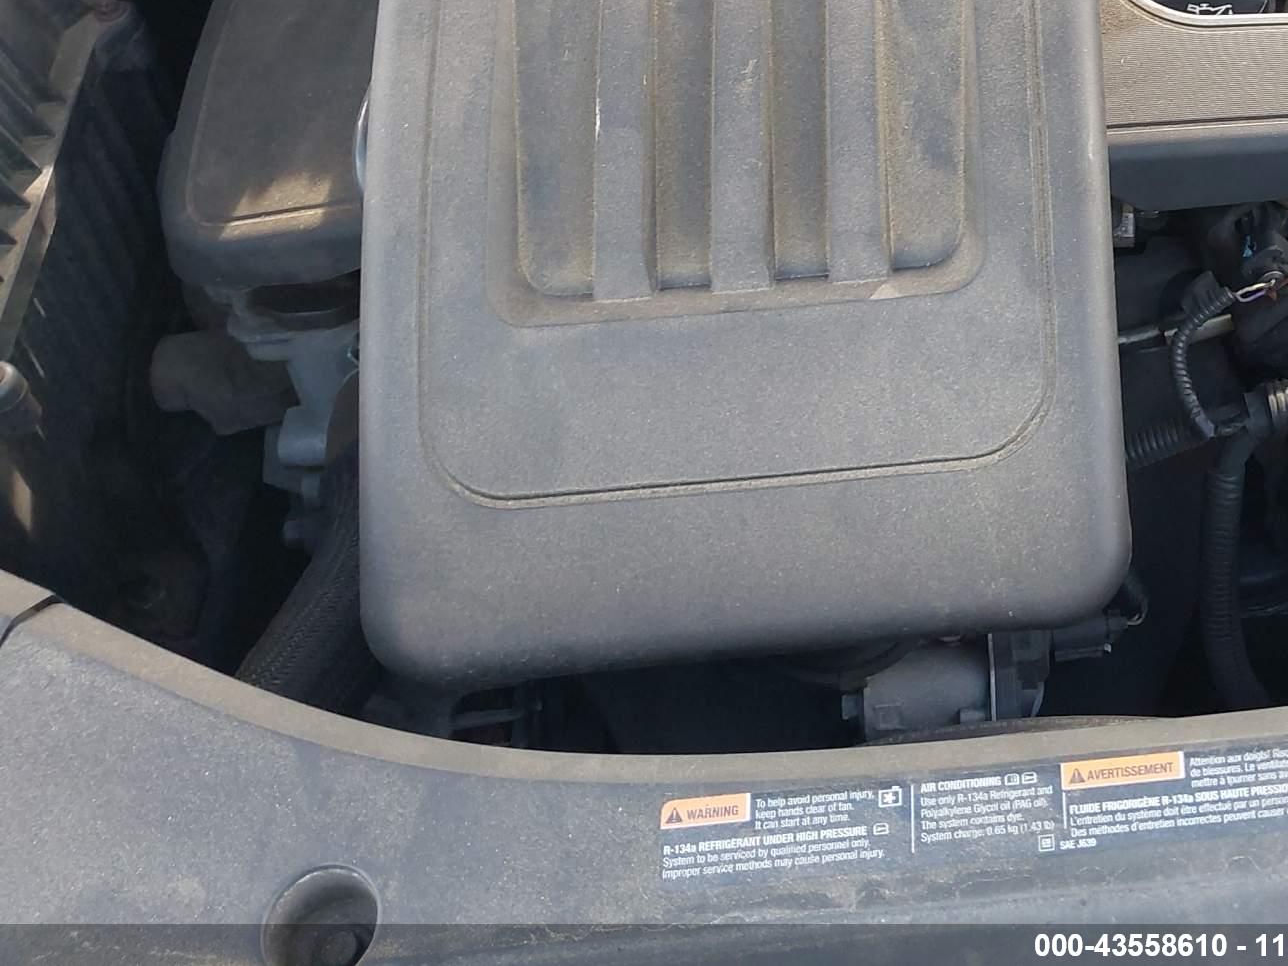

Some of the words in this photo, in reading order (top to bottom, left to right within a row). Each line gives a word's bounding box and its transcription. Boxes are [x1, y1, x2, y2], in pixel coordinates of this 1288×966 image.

[1190, 755, 1226, 767] Attention
[1227, 754, 1242, 763] aux
[1191, 769, 1201, 777] de
[1203, 764, 1243, 776] blessures.
[1245, 763, 1255, 771] Le
[1087, 762, 1174, 781] AVERTISSEMENT
[1192, 777, 1217, 788] mettre
[1219, 776, 1226, 784] à
[1227, 774, 1256, 786] tourner
[1258, 772, 1277, 781] sans
[920, 782, 937, 793] AIR
[938, 776, 1001, 791] CONDITIONING
[756, 799, 765, 809] To
[767, 797, 786, 809] help
[787, 795, 810, 806] avoid
[812, 791, 848, 804] personal
[849, 788, 875, 801] injury,
[920, 797, 936, 806] Use
[937, 795, 956, 807] only
[957, 792, 989, 803] R-134a
[990, 788, 1036, 802] Refrigerant
[1037, 786, 1053, 795] and
[1069, 803, 1101, 814] FLUIDE
[1102, 795, 1161, 811] FRIGORIGÈNE
[1162, 794, 1194, 806] R-134a
[1195, 790, 1219, 802] SOUS
[1220, 787, 1249, 799] HAUTE
[687, 804, 739, 821] WARNING
[755, 809, 776, 821] keep
[778, 806, 804, 817] hands
[806, 804, 826, 814] clear
[828, 802, 837, 812] of
[838, 801, 854, 811] fan.
[921, 805, 972, 819] Polyalkylene
[973, 803, 999, 815] Glycol
[1000, 801, 1011, 810] oil
[1012, 799, 1032, 810] (PAG
[1033, 798, 1048, 808] oil).
[1070, 814, 1113, 826] L'entretien
[1114, 812, 1126, 822] du
[1127, 808, 1162, 822] système
[1163, 807, 1179, 816] doit
[1199, 801, 1232, 813] effectué
[1234, 801, 1247, 810] par
[755, 822, 761, 830] It
[763, 821, 779, 829] can
[781, 817, 800, 828] start
[802, 817, 811, 826] at
[812, 816, 828, 826] any
[829, 813, 850, 823] time.
[921, 820, 937, 830] The
[938, 818, 968, 829] system
[969, 814, 1005, 825] contains
[1007, 813, 1024, 823] dye.
[921, 831, 952, 843] System
[954, 828, 985, 840] charge:
[986, 825, 1006, 836] 0.65
[1007, 824, 1019, 835] kg
[1020, 822, 1043, 834] (1.43
[1043, 820, 1055, 830] lb)
[1071, 828, 1088, 837] Des
[1089, 824, 1129, 836] méthodes
[1130, 819, 1175, 831] d'entretien
[1177, 814, 1222, 827] incorrectes
[1223, 811, 1256, 823] peuvent
[1257, 808, 1285, 818] causer
[663, 844, 696, 855] R-134a
[699, 837, 761, 852] REFRIGERANT
[763, 833, 794, 845] UNDER
[797, 831, 819, 842] HIGH
[820, 826, 868, 840] PRESSURE
[1060, 841, 1076, 850] SAE
[1076, 838, 1097, 848] J639
[663, 856, 695, 869] System
[696, 856, 705, 864] to
[707, 853, 718, 863] be
[720, 849, 756, 862] serviced
[758, 848, 769, 859] by
[771, 844, 807, 858] qualified
[809, 840, 850, 854] personnel
[851, 838, 871, 850] only.
[662, 867, 701, 881] Improper
[703, 864, 734, 875] service
[736, 859, 773, 872] methods
[774, 859, 792, 869] may
[794, 855, 820, 866] cause
[821, 850, 859, 864] personal
[859, 848, 884, 860] injury.
